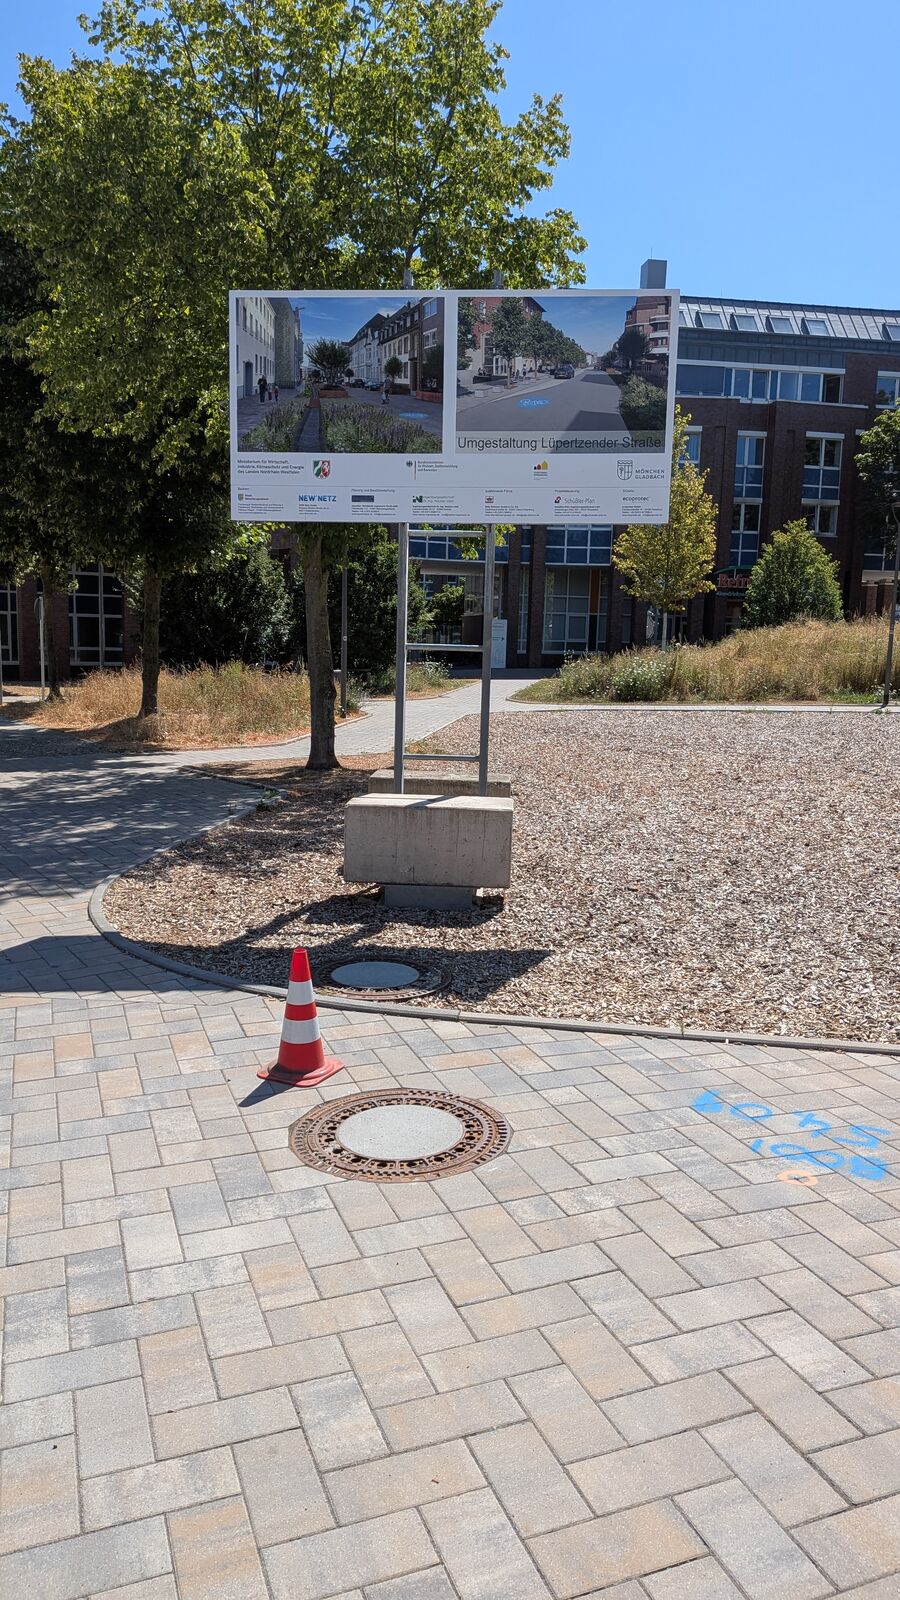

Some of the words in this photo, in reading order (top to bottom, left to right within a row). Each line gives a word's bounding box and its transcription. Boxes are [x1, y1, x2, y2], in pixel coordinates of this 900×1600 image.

[457, 437, 537, 452] Umgestaltung
[541, 436, 618, 451] Lüpertzender
[622, 436, 662, 449] Straße
